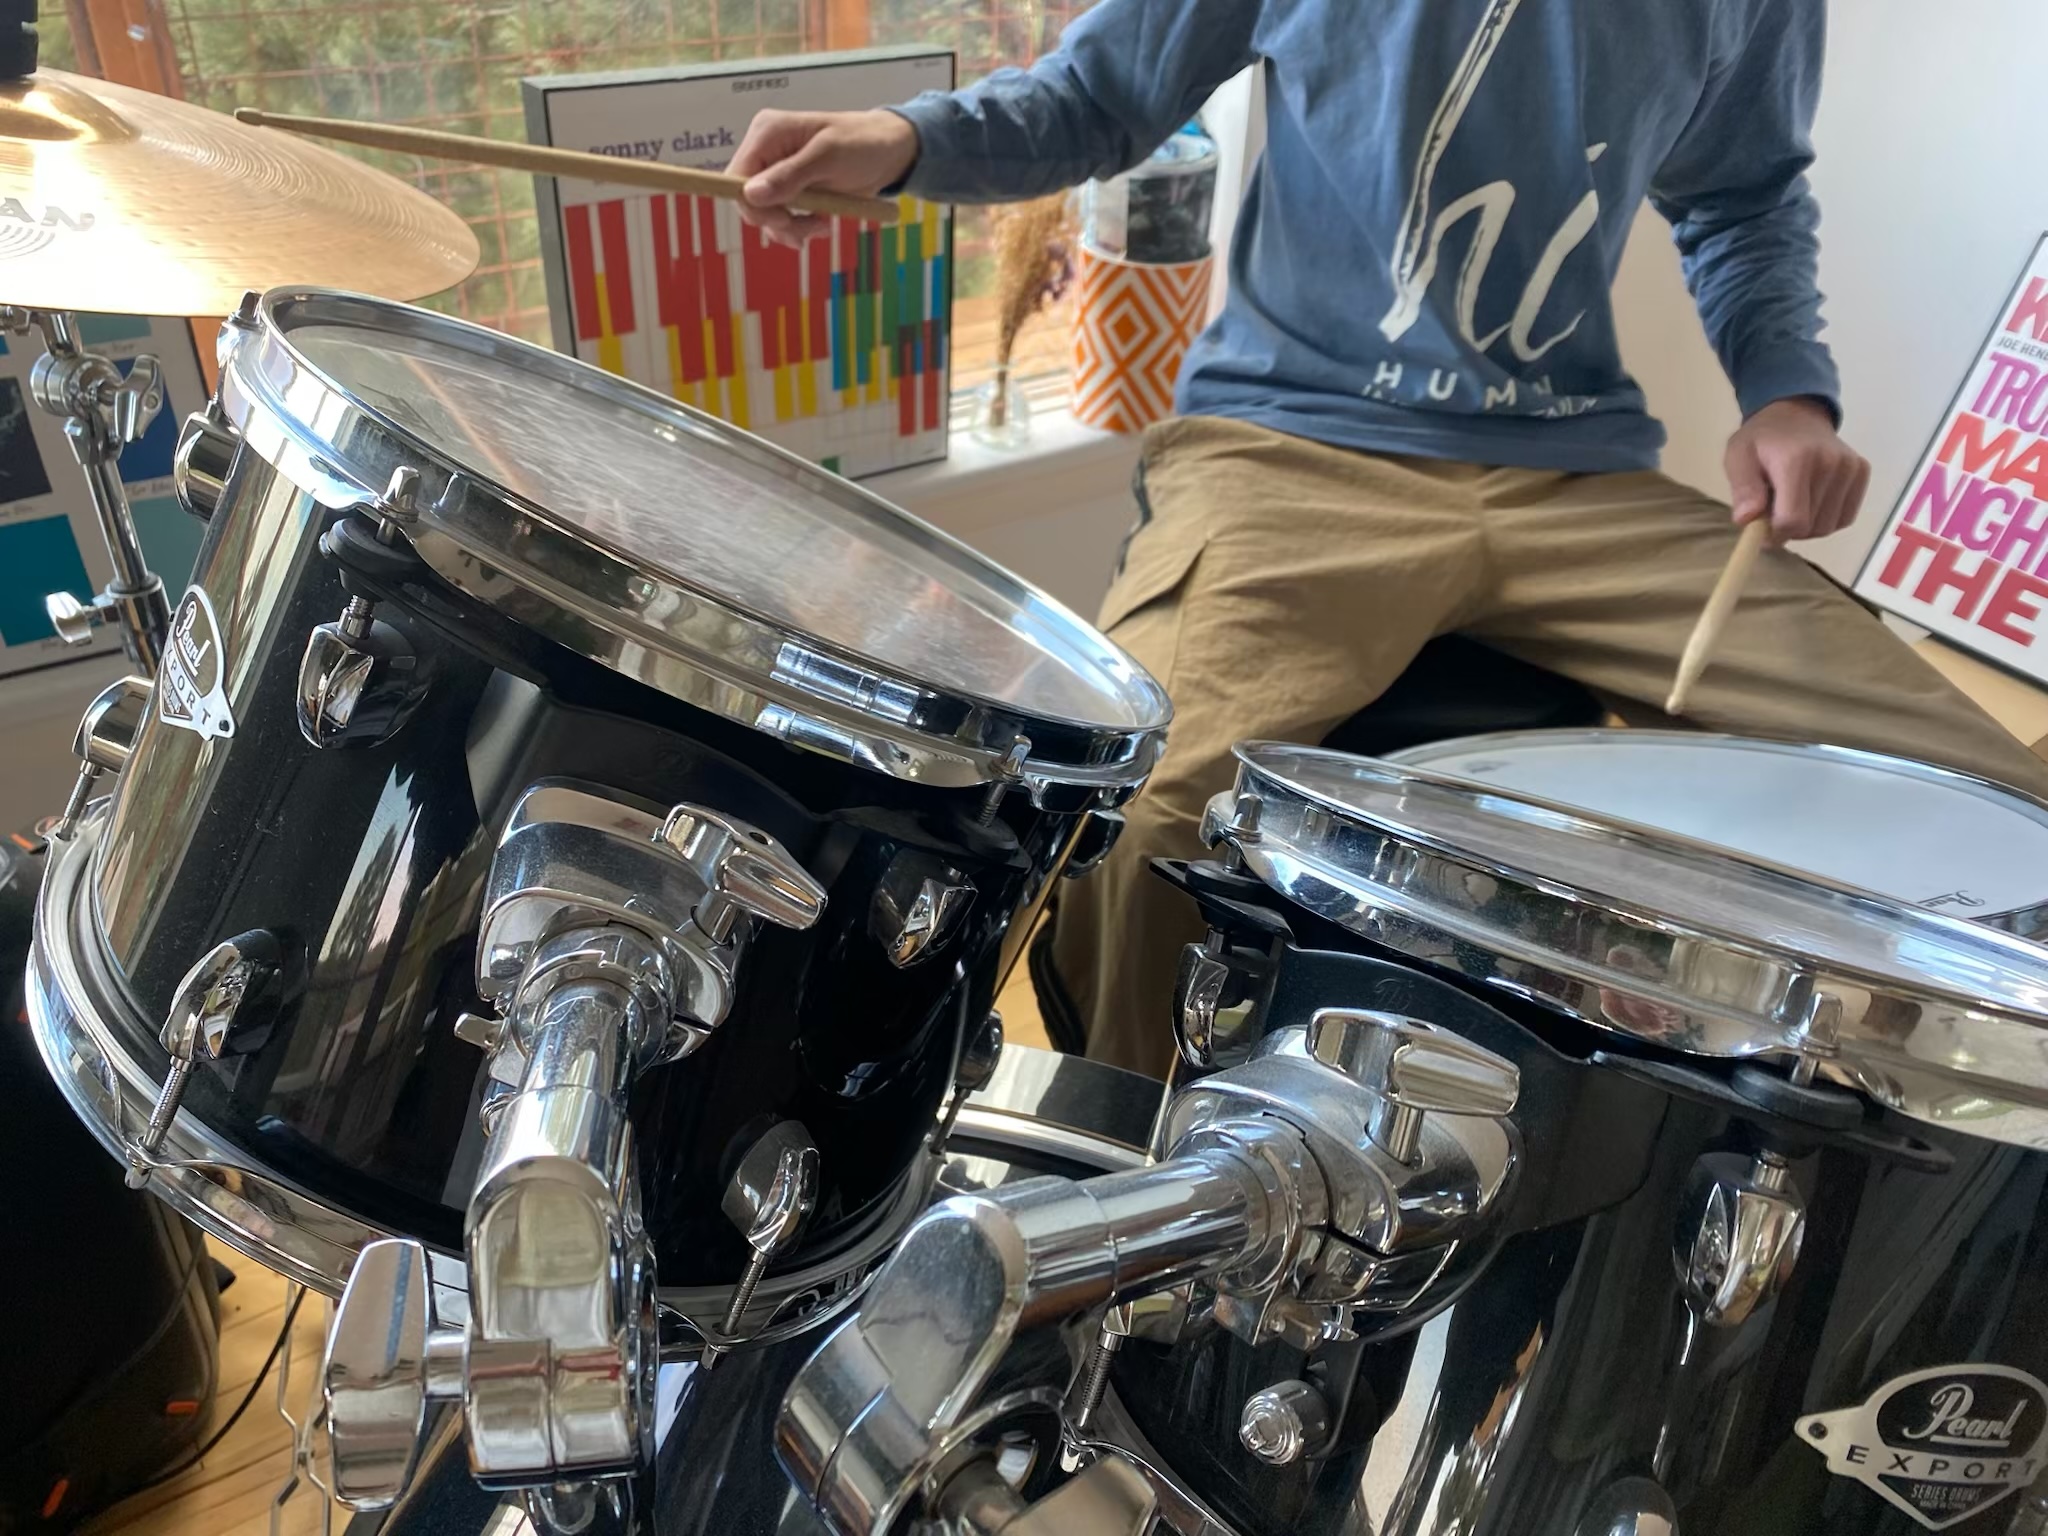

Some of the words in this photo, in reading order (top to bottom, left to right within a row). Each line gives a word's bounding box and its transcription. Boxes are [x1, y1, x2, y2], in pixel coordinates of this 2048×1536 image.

[672, 127, 734, 152] clark
[1997, 335, 2022, 352] JOE
[1903, 462, 2048, 581] NIGH
[1878, 522, 2048, 648] THE
[175, 600, 211, 677] Pearl
[1902, 1383, 2029, 1446] Pearl
[1845, 1443, 2038, 1479] EXPORT
[1911, 1484, 1948, 1499] SERIES
